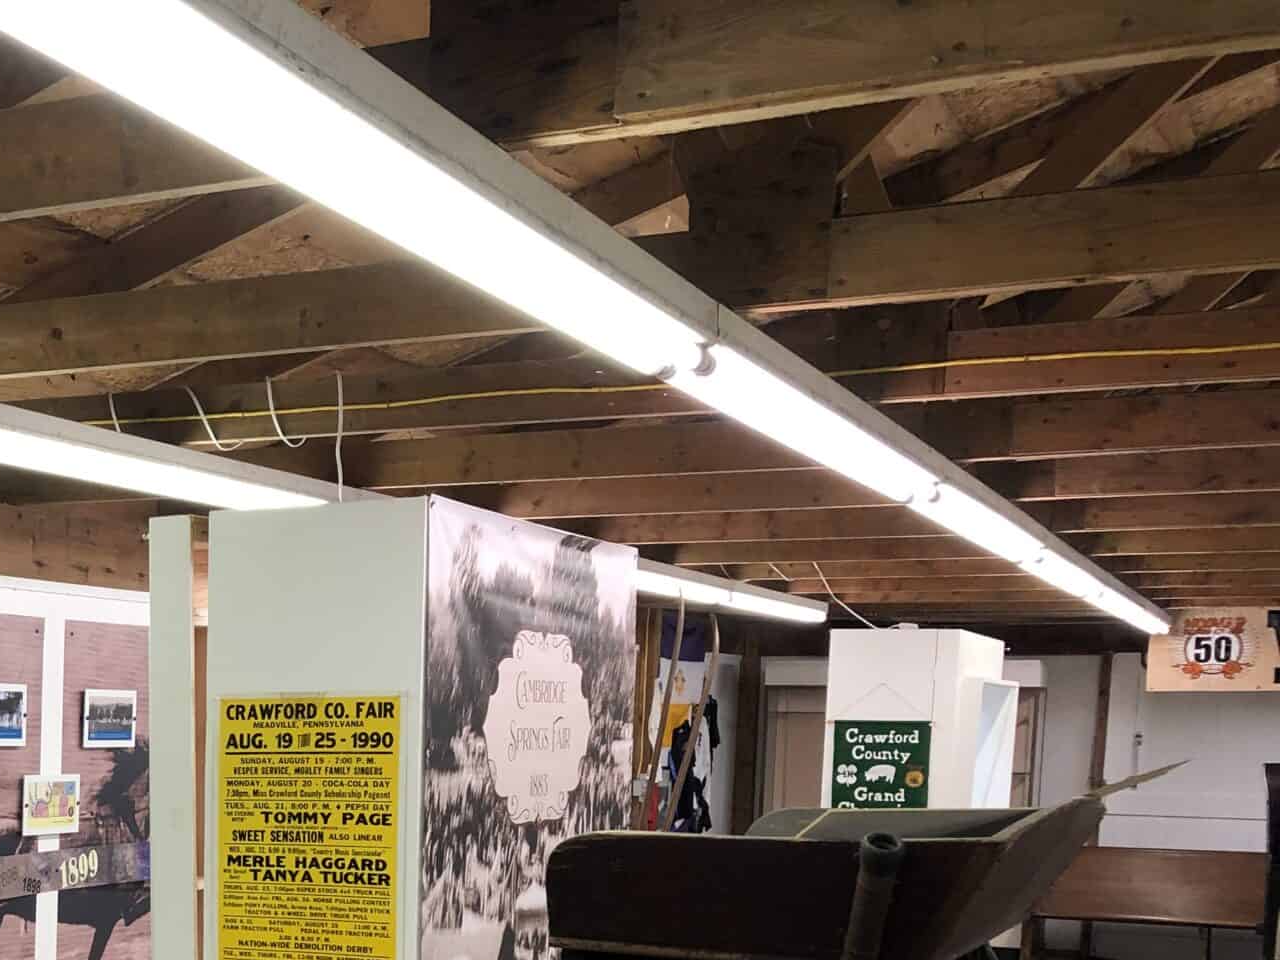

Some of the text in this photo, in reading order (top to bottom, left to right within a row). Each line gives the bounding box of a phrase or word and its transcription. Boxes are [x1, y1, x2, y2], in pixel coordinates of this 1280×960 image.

[1193, 636, 1233, 663] 50
[515, 671, 568, 710] CAMBRIDGE
[226, 702, 394, 720] CRAWFORD CO. FAIR
[253, 720, 364, 729] MEADVILLE, PENNSYLVANIA
[226, 732, 267, 749] AUG.
[275, 732, 293, 748] 19
[314, 732, 336, 748] 25
[351, 731, 393, 748] 1990
[507, 716, 571, 762] SPRINGS FAIR
[845, 728, 920, 743] Crawford
[851, 745, 911, 764] County
[324, 766, 350, 775] FAMILY
[226, 780, 263, 788] MONDAY,
[372, 780, 390, 788] DAY
[854, 787, 905, 802] Grand
[345, 803, 369, 811] PEPSI
[261, 811, 332, 825] TOMMY
[342, 812, 392, 826] PAGE
[232, 830, 265, 842] SWEET
[270, 830, 324, 843] SENSATION
[328, 833, 350, 841] ALSO
[59, 849, 99, 888] 1899
[227, 854, 387, 871] MERLE HAGGARD
[249, 869, 314, 883] TANYA
[320, 871, 391, 886] TUCKER
[238, 940, 373, 954] NATION-WIDE DEMOLITION DERBY
